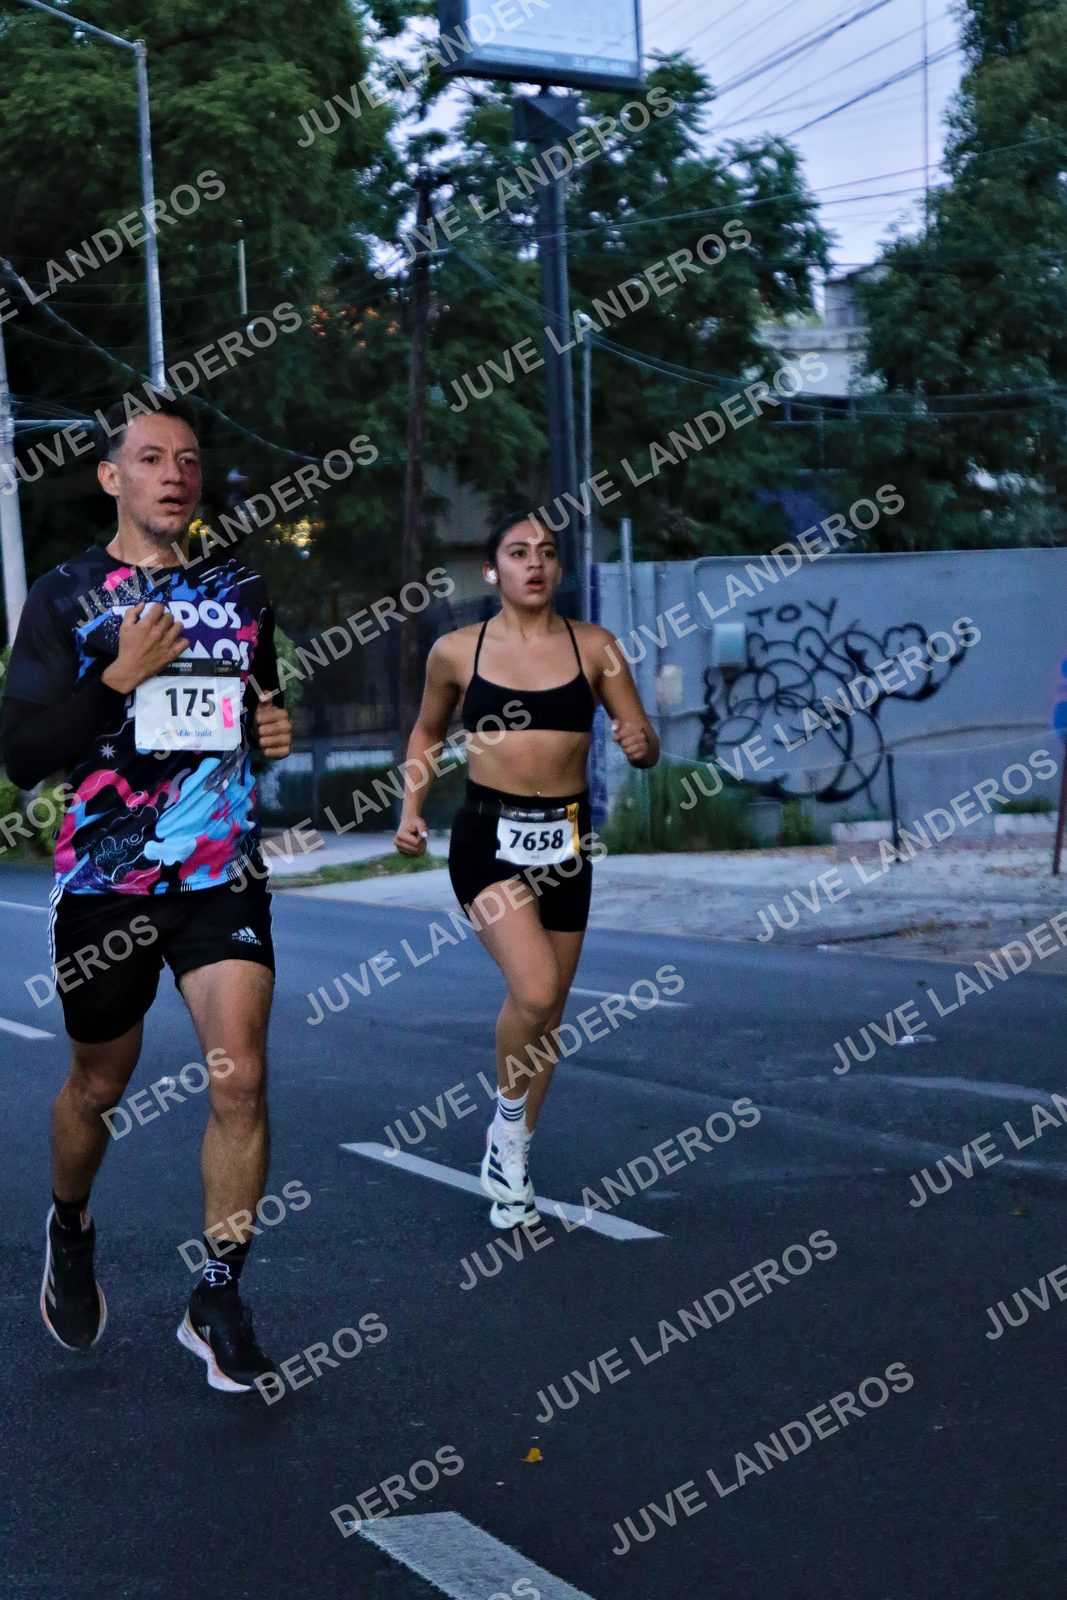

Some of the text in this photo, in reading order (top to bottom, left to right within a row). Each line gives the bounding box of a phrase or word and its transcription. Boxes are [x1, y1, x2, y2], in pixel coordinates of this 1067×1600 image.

[747, 598, 836, 632] TOY
[165, 688, 215, 717] 175
[180, 729, 212, 738] Eletrolit
[509, 828, 563, 851] 7658
